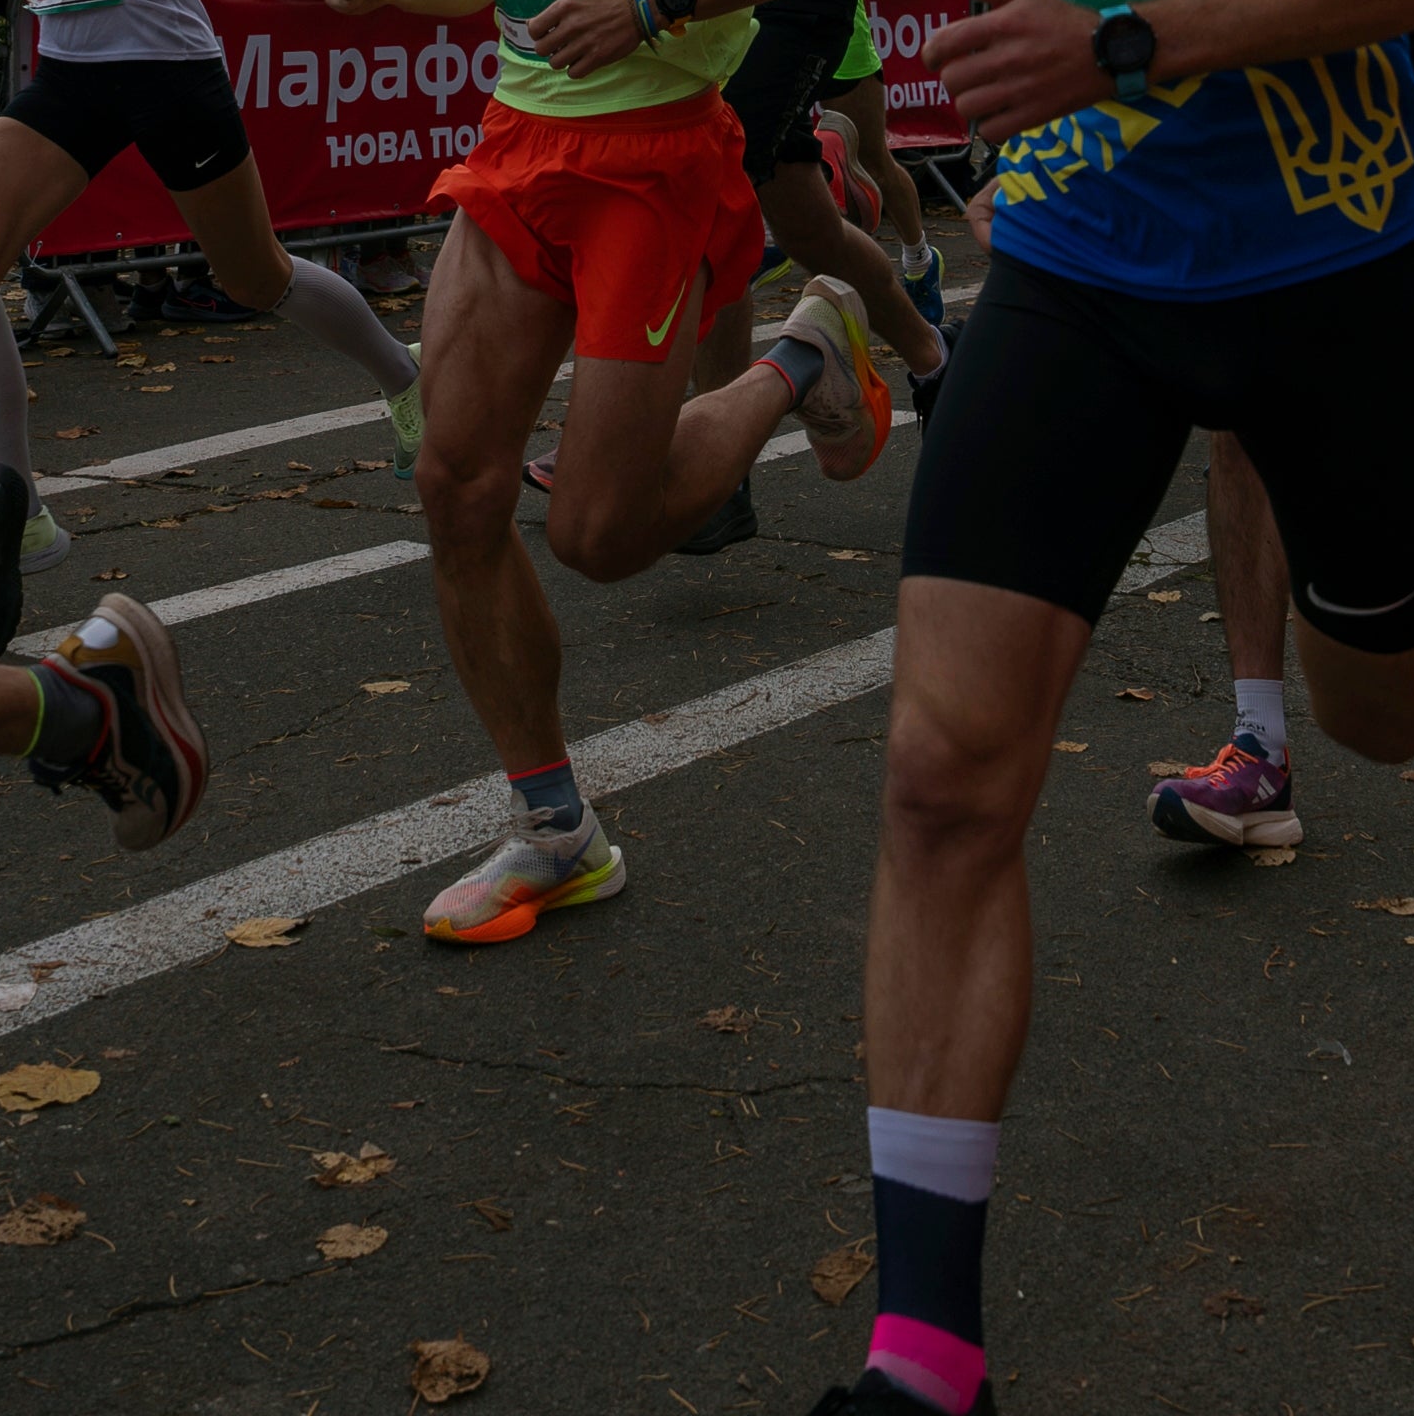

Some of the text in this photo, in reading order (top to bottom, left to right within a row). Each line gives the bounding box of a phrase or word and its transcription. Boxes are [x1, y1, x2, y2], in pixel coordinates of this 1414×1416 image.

[223, 25, 499, 123] Марафо
[883, 80, 951, 111] ОШТА
[326, 130, 424, 168] НОВА
